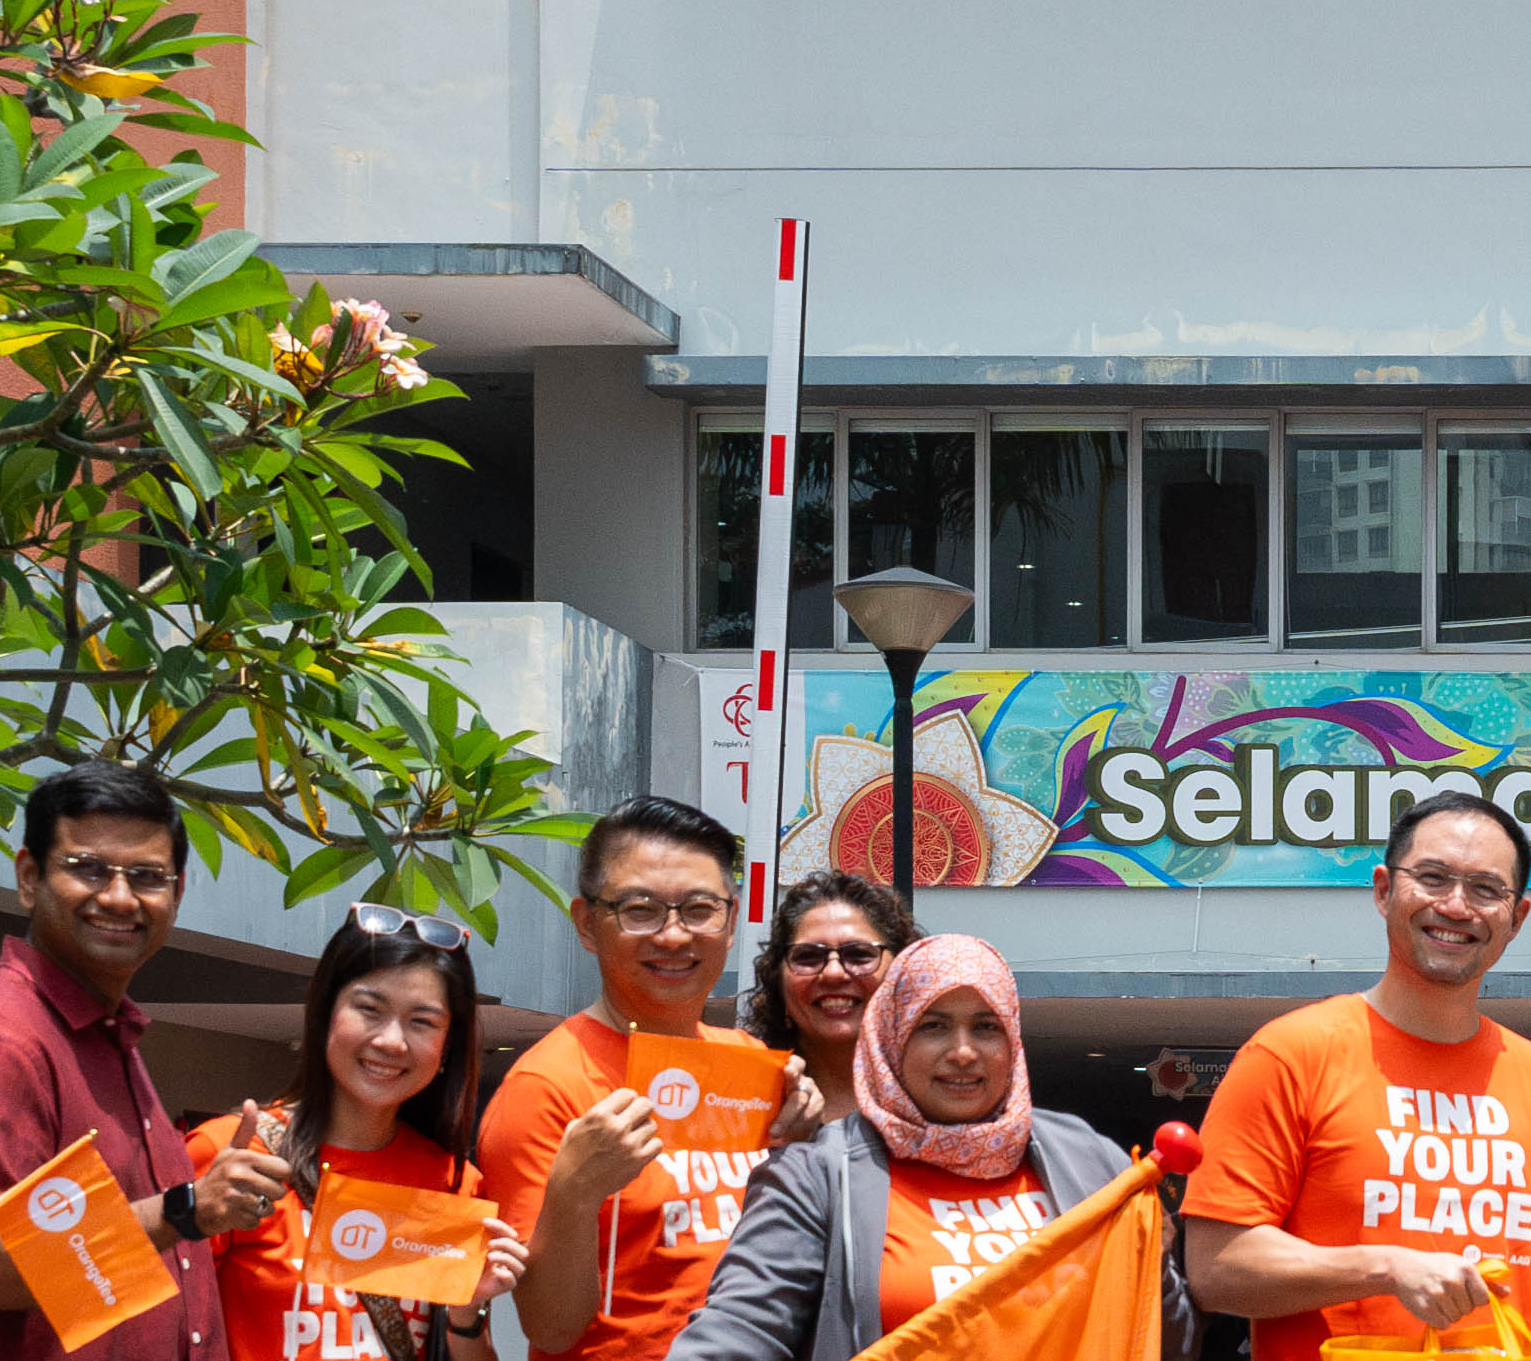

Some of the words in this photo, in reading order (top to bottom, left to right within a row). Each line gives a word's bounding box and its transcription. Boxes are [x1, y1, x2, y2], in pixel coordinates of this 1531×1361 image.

[1385, 1085, 1510, 1136] FIND
[1375, 1128, 1527, 1188] YOUR
[929, 1191, 1056, 1231] FIND
[68, 1232, 117, 1307] OrangeTee
[391, 1236, 467, 1260] OrangeTee
